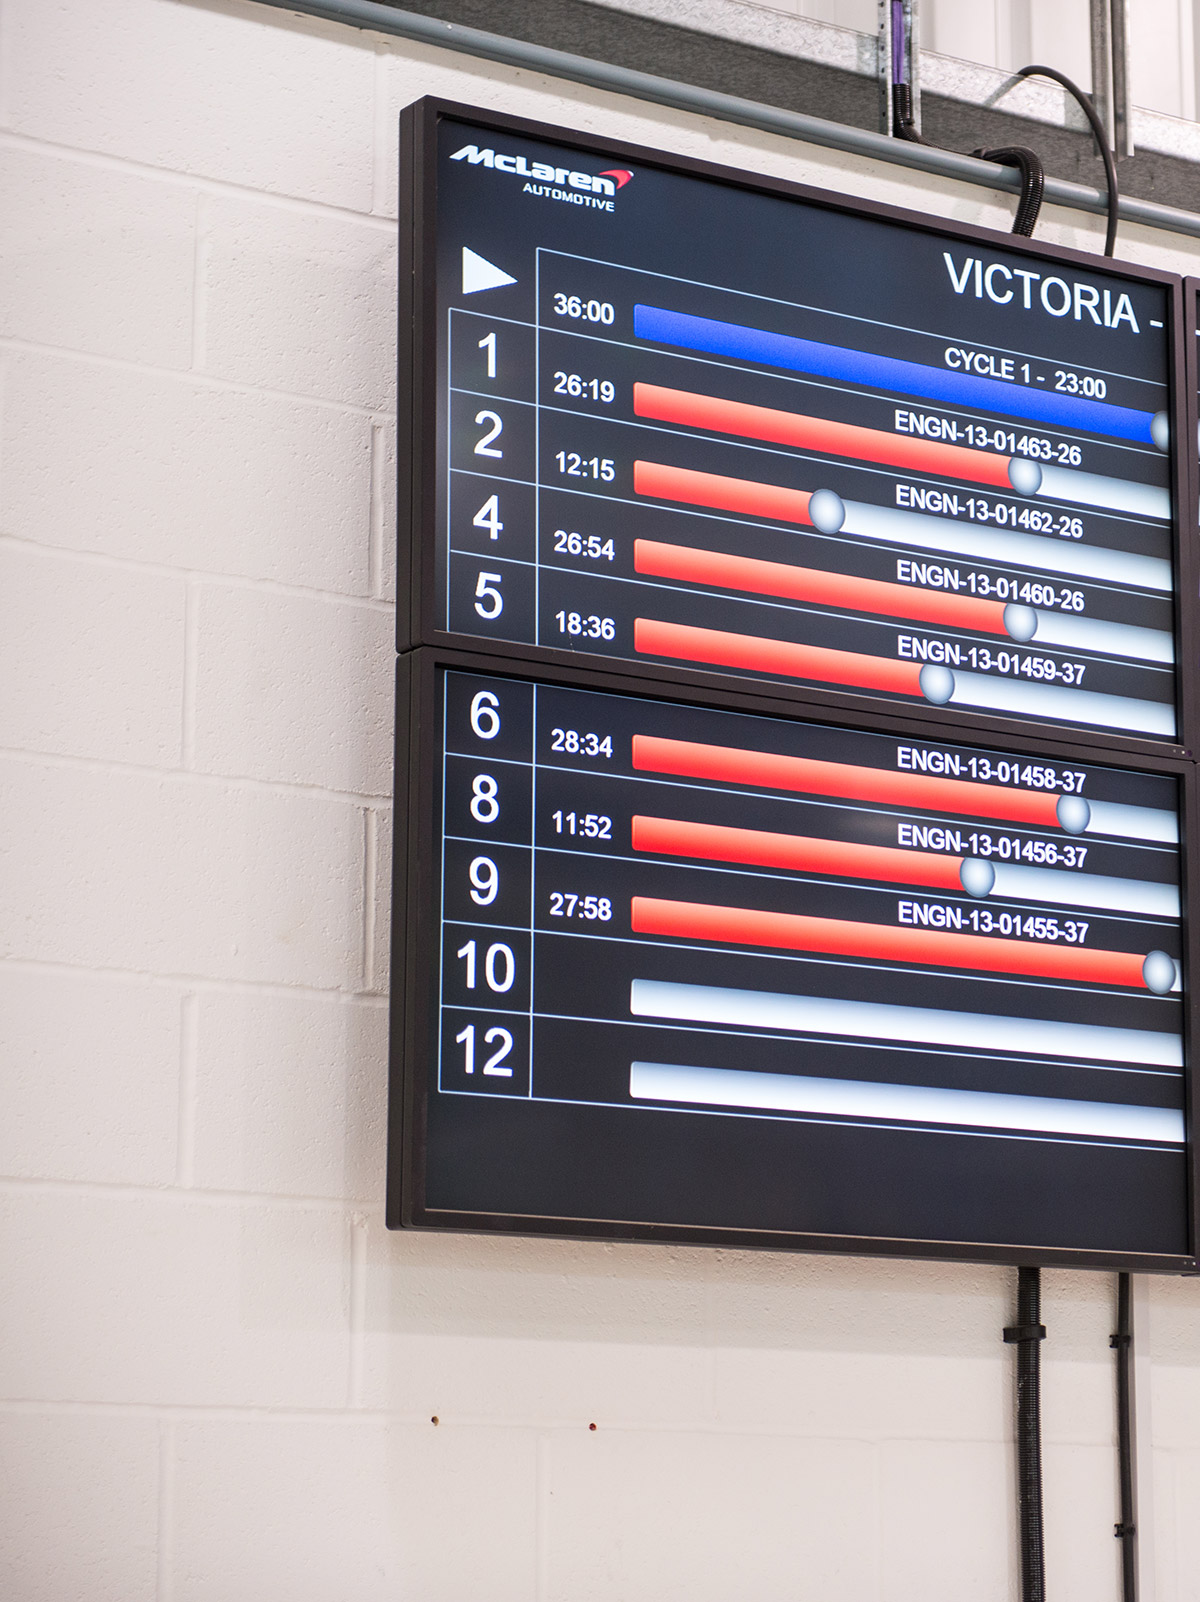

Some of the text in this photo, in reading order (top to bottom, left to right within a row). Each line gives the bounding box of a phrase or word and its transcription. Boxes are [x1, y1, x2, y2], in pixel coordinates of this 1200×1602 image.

[449, 144, 617, 197] McLaren
[522, 182, 615, 212] AUTOMOTIVE
[553, 292, 615, 325] 36:00
[942, 252, 1140, 334] VICTORIA
[478, 332, 496, 378] 1
[944, 346, 1015, 380] CYCLE
[1020, 363, 1030, 384] 1
[1054, 370, 1107, 399] 23:00
[553, 371, 615, 403] 26:19
[473, 409, 503, 459] 2
[894, 409, 1082, 466] ENGN-13-01463-26
[555, 450, 615, 482] 12:15
[472, 494, 504, 541] 4
[895, 483, 1084, 539] ENGN-13-01462-26
[553, 529, 616, 561] 26:54
[474, 571, 503, 620] 5
[896, 558, 1085, 612] ENGN-13-01460-26
[555, 610, 615, 641] 18:36
[897, 634, 1086, 685] ENGN-13-01459-37
[470, 690, 500, 740] 6
[551, 728, 613, 758] 28:34
[897, 746, 1087, 794] ENGN-13-01458-37
[470, 774, 499, 823] 8
[552, 810, 612, 840] 11:52
[897, 822, 1088, 868] ENGN-13-01456-37
[469, 856, 499, 906] 9
[549, 892, 612, 921] 27:58
[898, 900, 1089, 944] ENGN-13-01455-37
[457, 940, 515, 993] 10
[455, 1024, 513, 1077] 12
